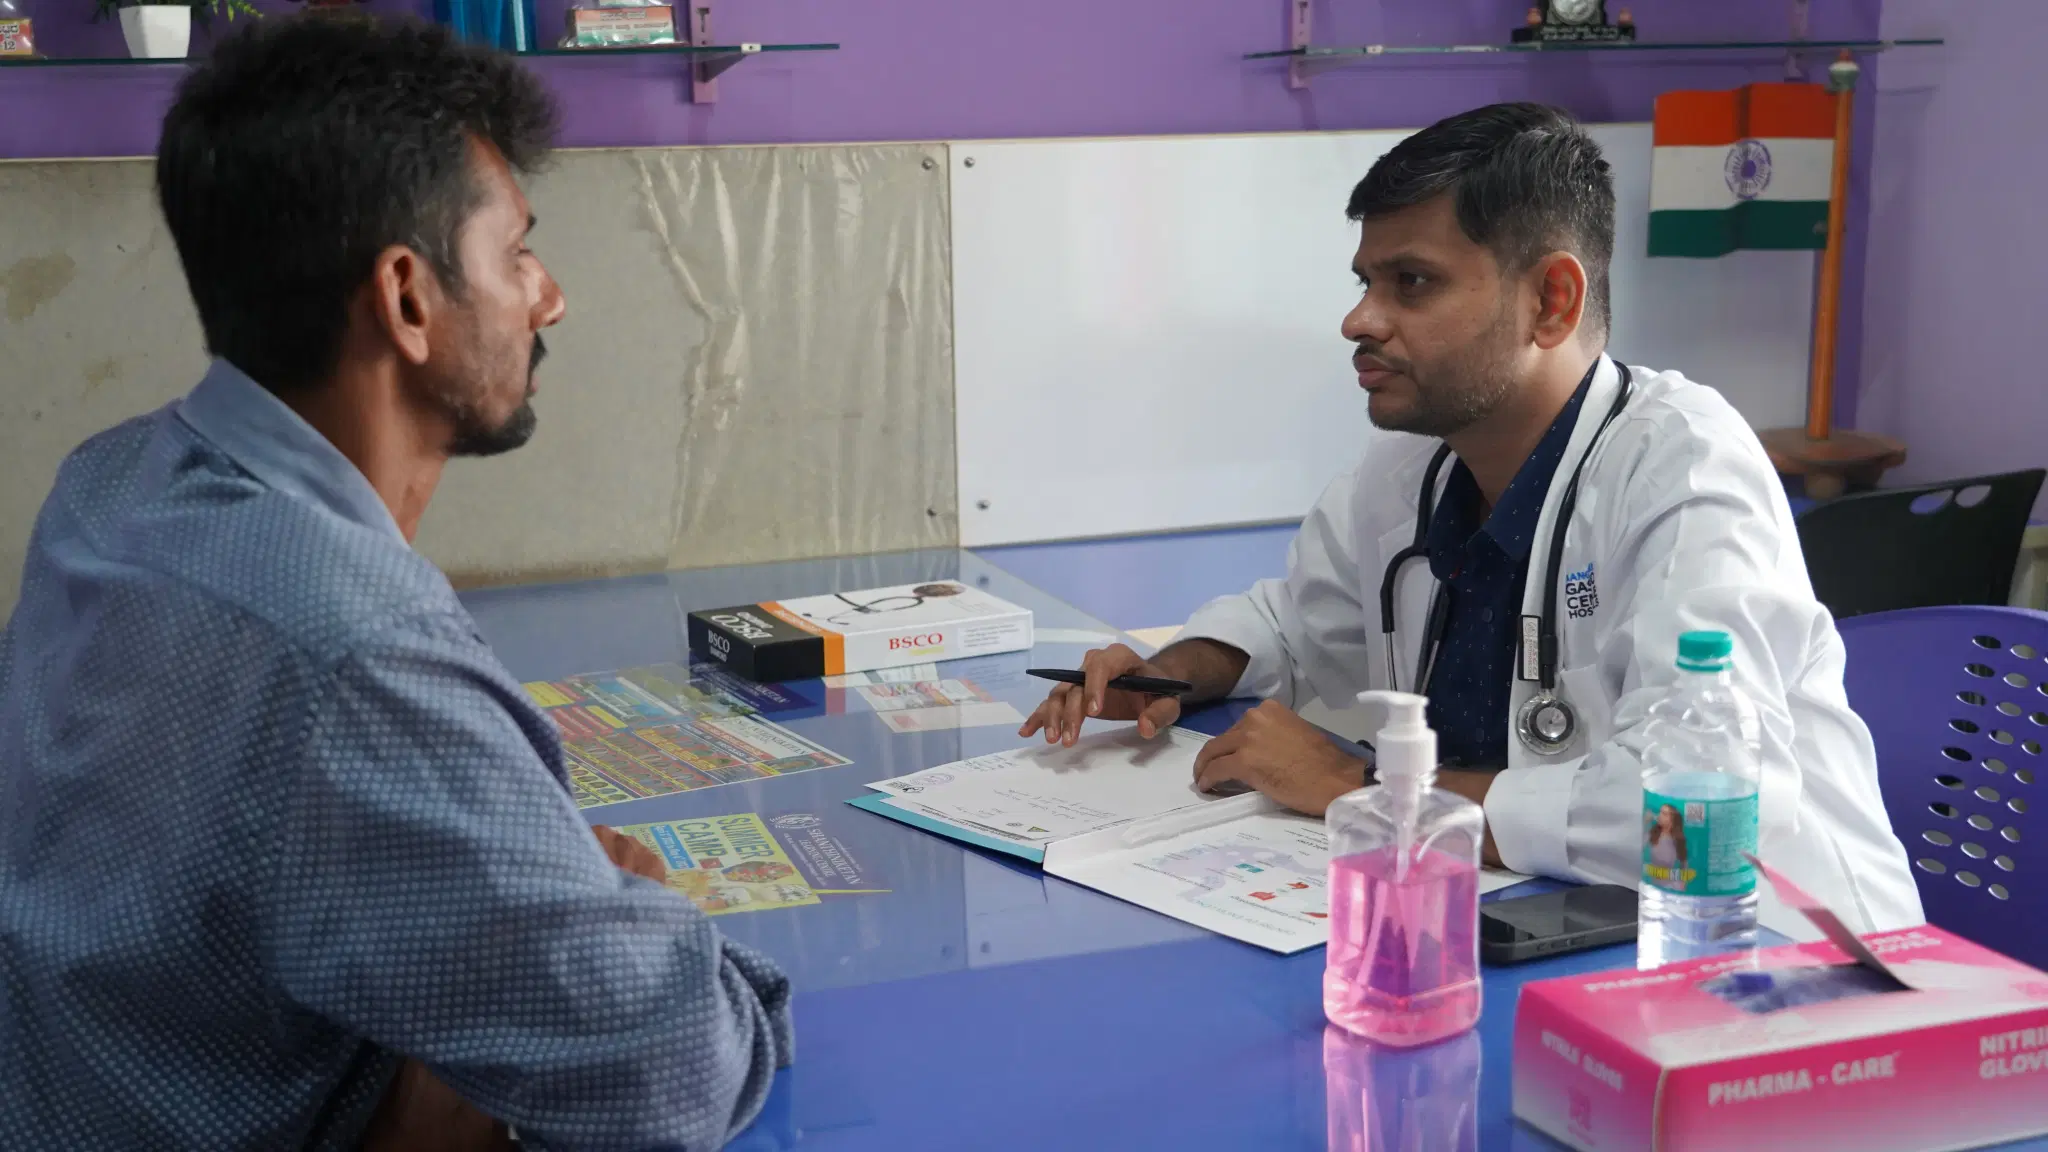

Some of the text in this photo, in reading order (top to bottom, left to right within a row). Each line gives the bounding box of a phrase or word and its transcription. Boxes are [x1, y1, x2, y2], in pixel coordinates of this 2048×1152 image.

[708, 629, 731, 654] BSCO
[889, 632, 943, 651] BSCO
[676, 822, 728, 857] CAMP
[716, 817, 775, 860] SUMMER
[1979, 1026, 2048, 1057] NITRI
[1708, 1069, 1813, 1107] PHARMA
[1831, 1054, 1895, 1087] CARE
